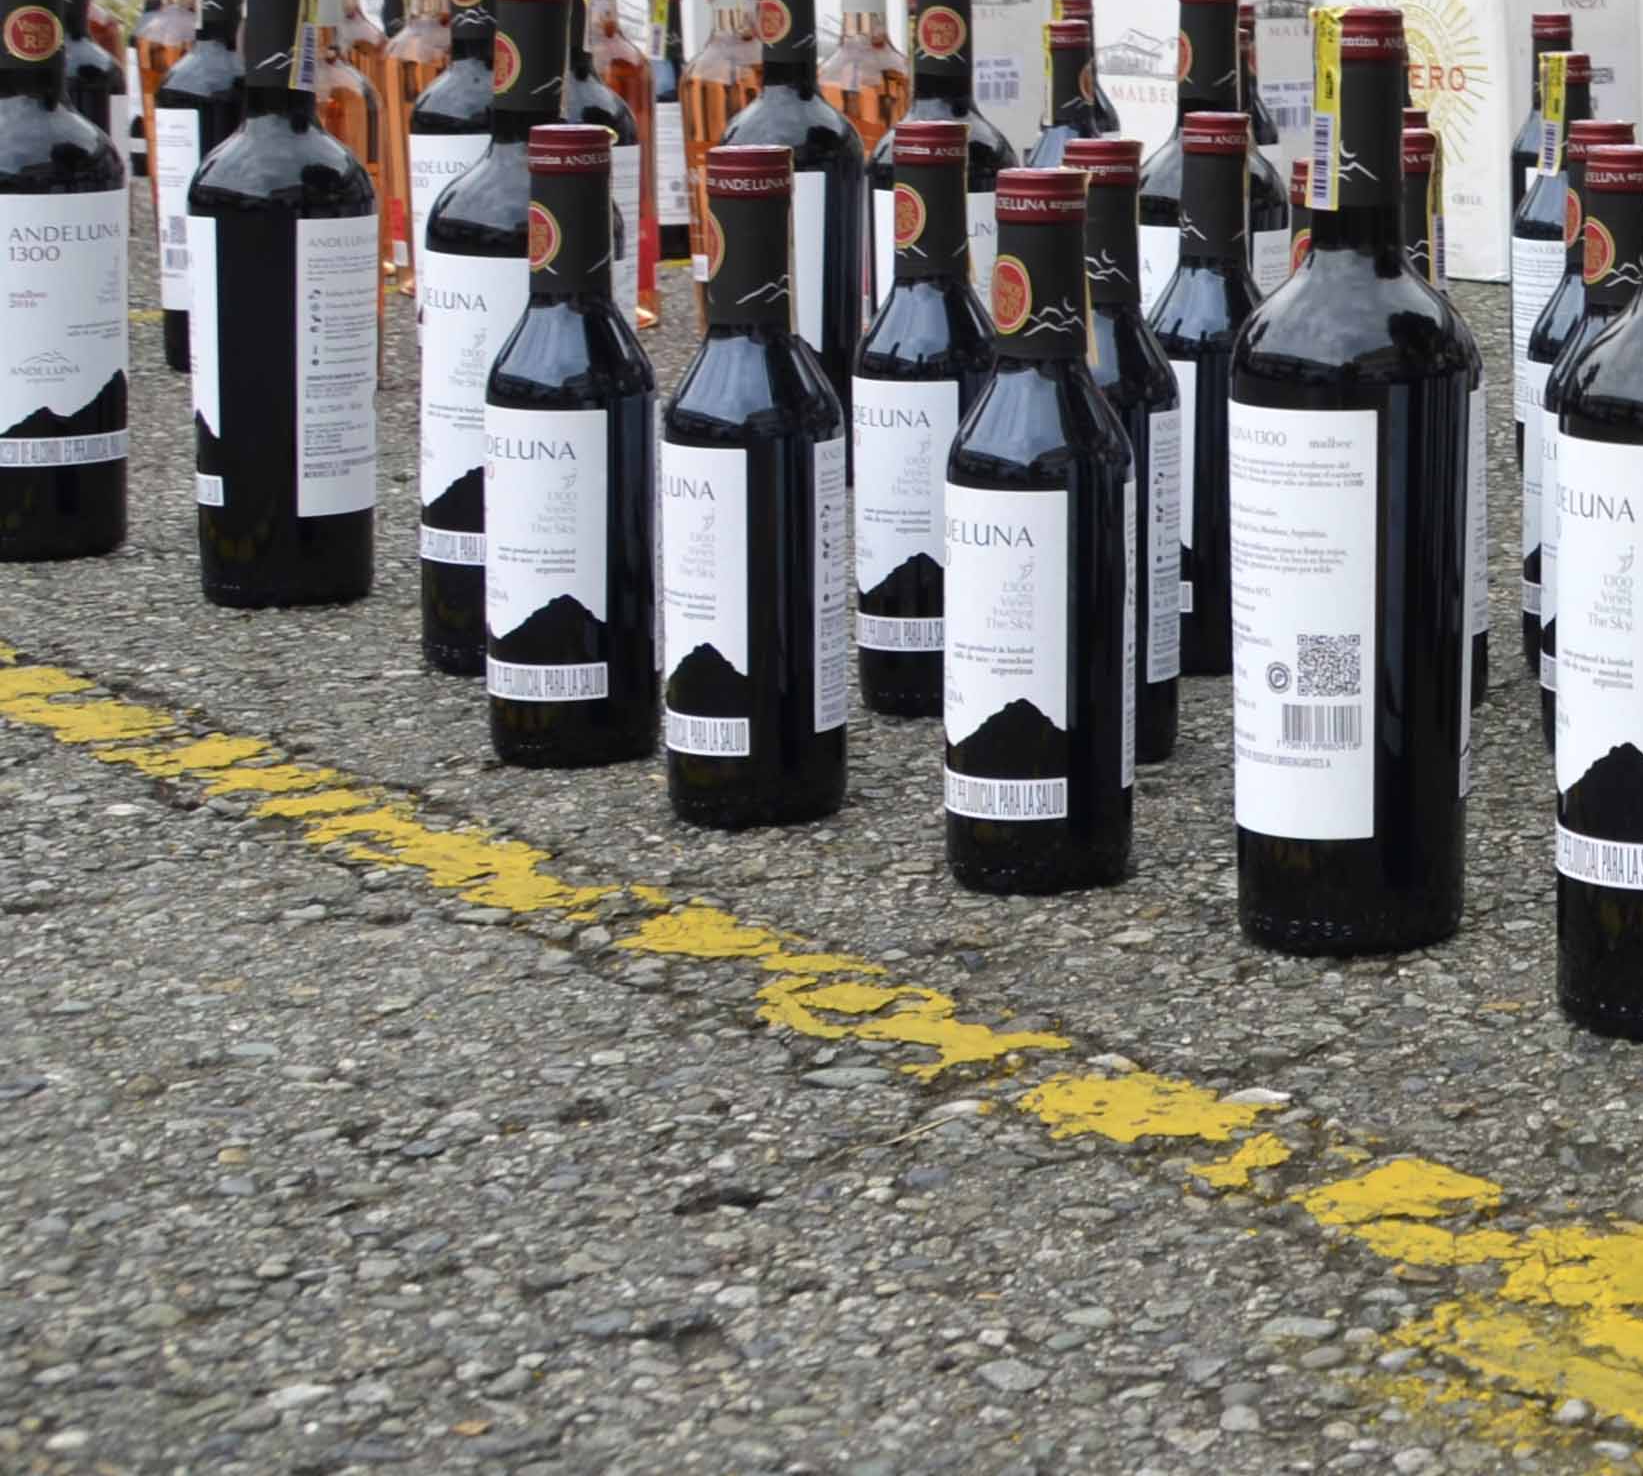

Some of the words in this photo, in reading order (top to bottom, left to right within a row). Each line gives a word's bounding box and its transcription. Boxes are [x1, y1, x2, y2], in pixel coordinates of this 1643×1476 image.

[9, 223, 121, 244] ANDELUNA
[9, 246, 60, 262] 1300
[10, 364, 80, 375] ANDELUNA
[1255, 428, 1287, 447] 1300
[1308, 437, 1352, 450] malbec
[1602, 846, 1625, 885] PARA
[1626, 847, 1640, 885] LA
